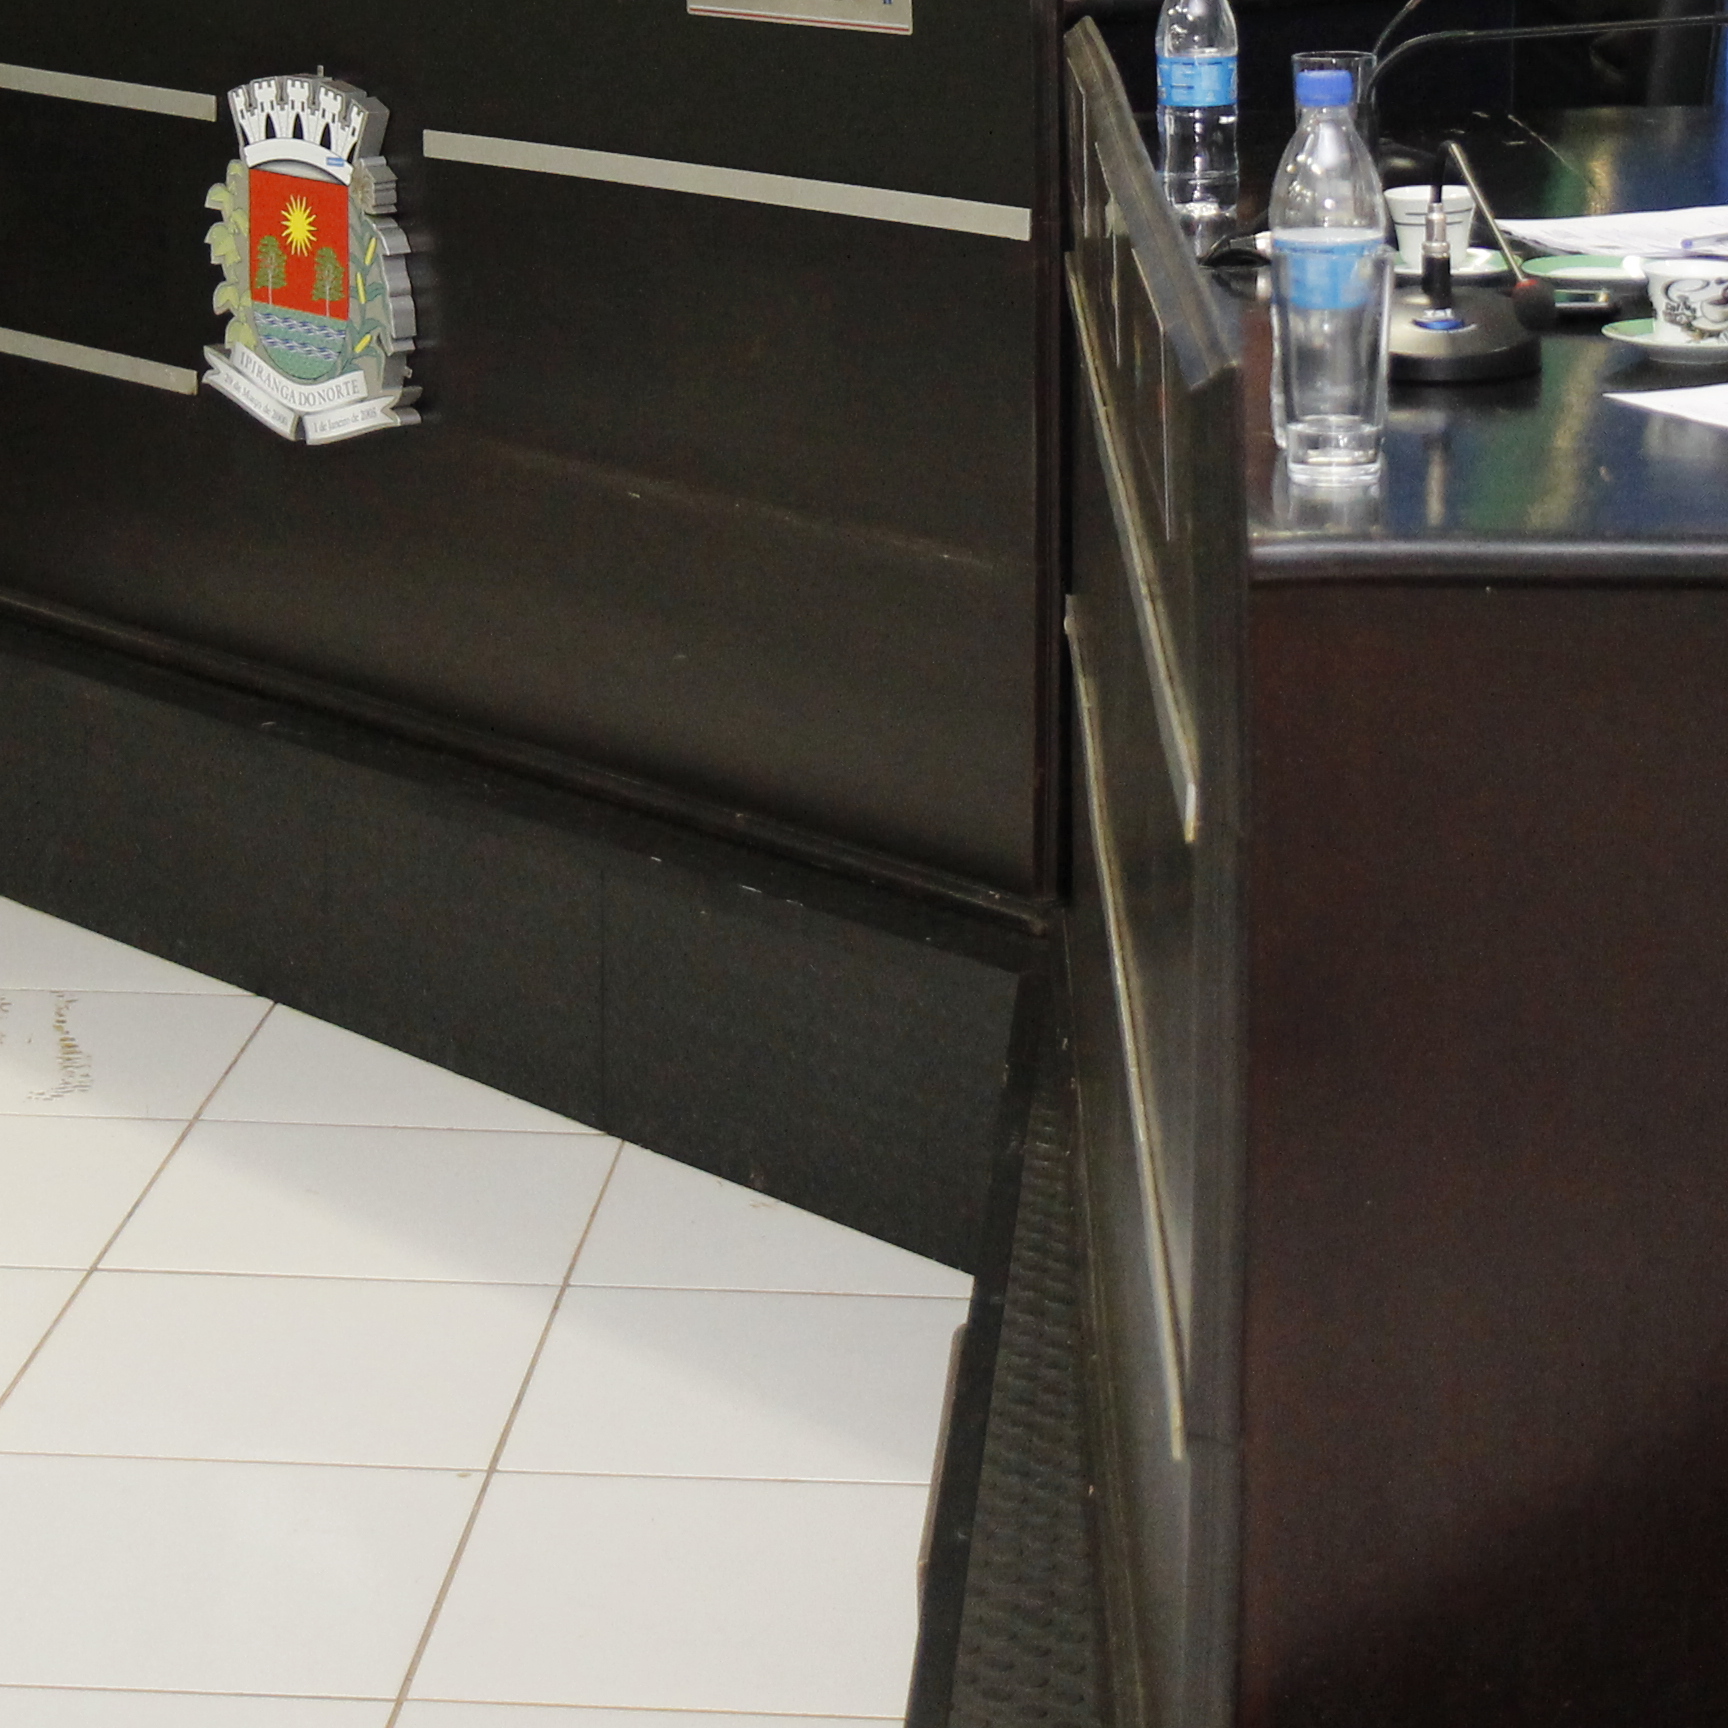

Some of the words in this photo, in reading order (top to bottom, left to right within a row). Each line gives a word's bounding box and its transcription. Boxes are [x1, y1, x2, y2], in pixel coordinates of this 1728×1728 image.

[239, 351, 298, 406] IPIRANGA
[298, 392, 316, 407] DO
[317, 379, 360, 405] NORTE
[319, 419, 328, 433] de
[351, 412, 359, 425] de
